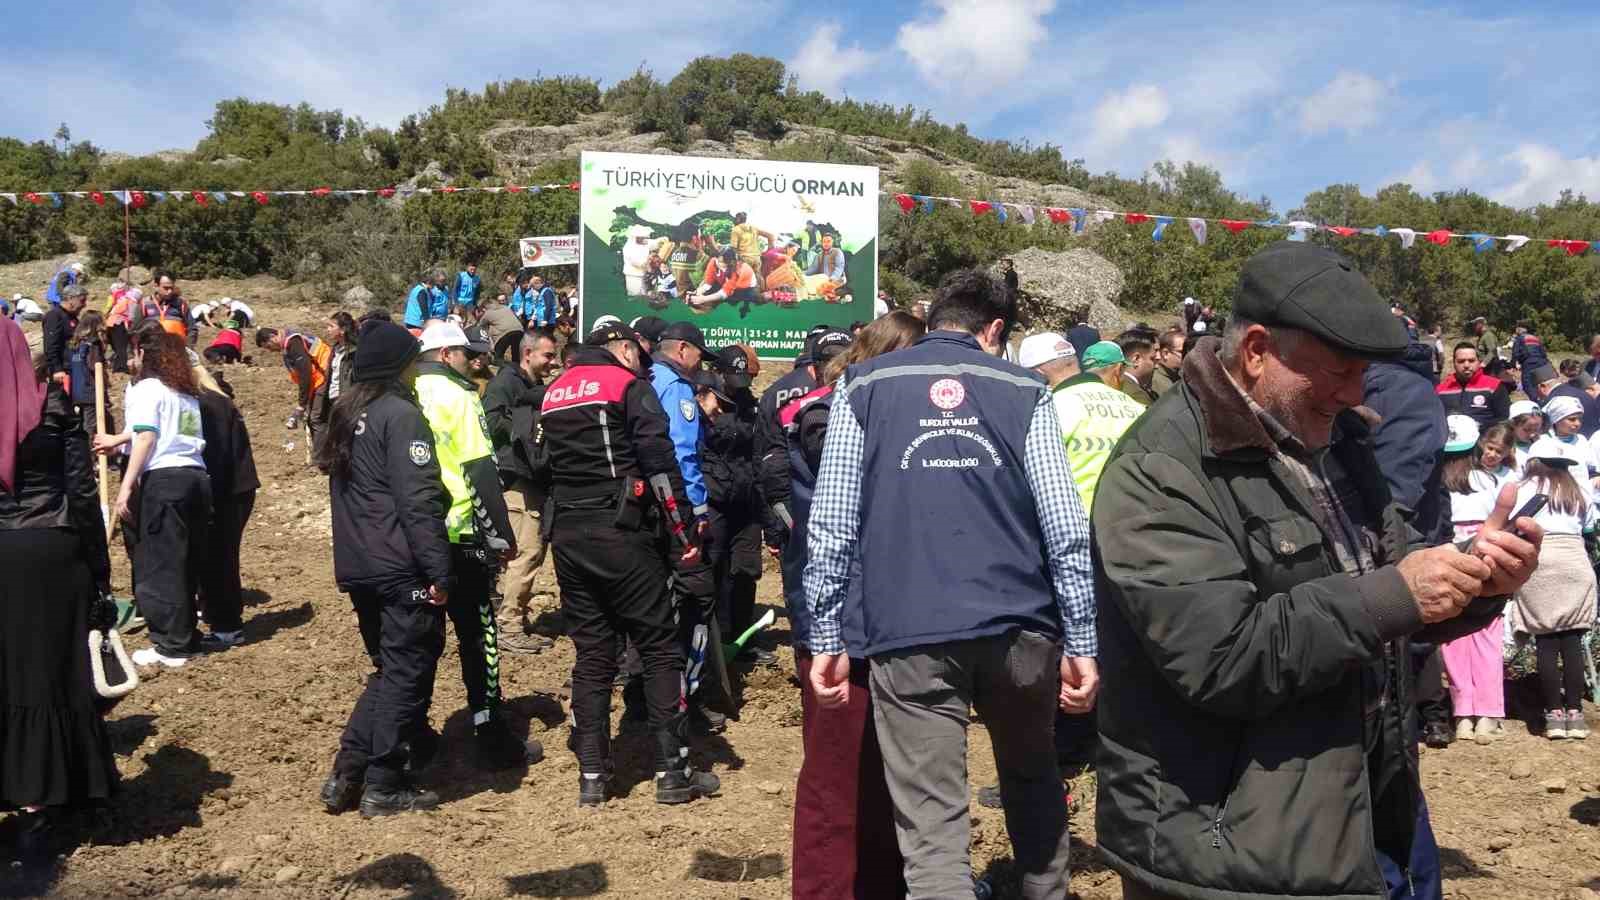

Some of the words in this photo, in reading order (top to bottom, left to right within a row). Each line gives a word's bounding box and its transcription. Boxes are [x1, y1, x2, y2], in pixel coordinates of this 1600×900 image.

[602, 166, 725, 190] TÜRKİYE'NİN
[731, 172, 786, 193] GÜCÜ
[792, 179, 864, 197] ORMAN
[711, 326, 742, 337] DÜNYA
[785, 330, 808, 339] MAR
[749, 340, 779, 349] ORMAN
